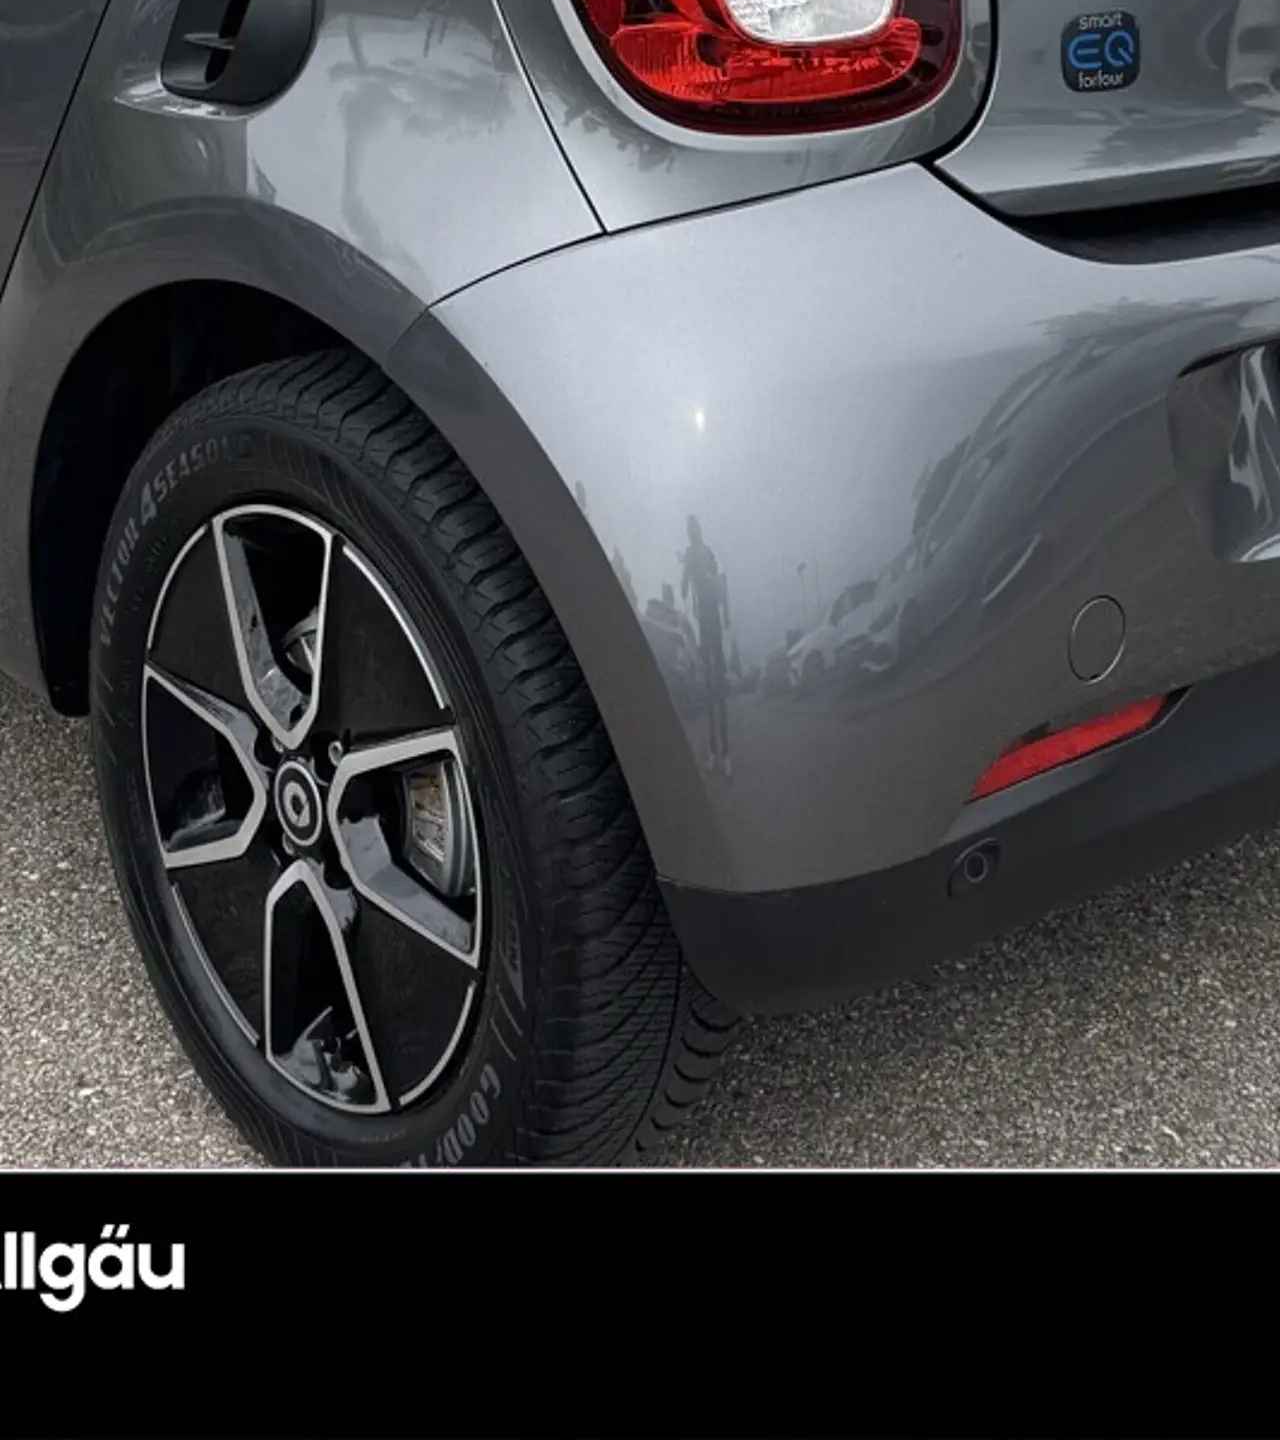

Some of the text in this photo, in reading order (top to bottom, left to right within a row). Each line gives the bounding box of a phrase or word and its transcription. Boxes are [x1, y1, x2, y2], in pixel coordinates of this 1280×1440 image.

[1079, 12, 1123, 30] smart
[1068, 29, 1135, 69] EQ
[101, 516, 140, 646] VECTOR
